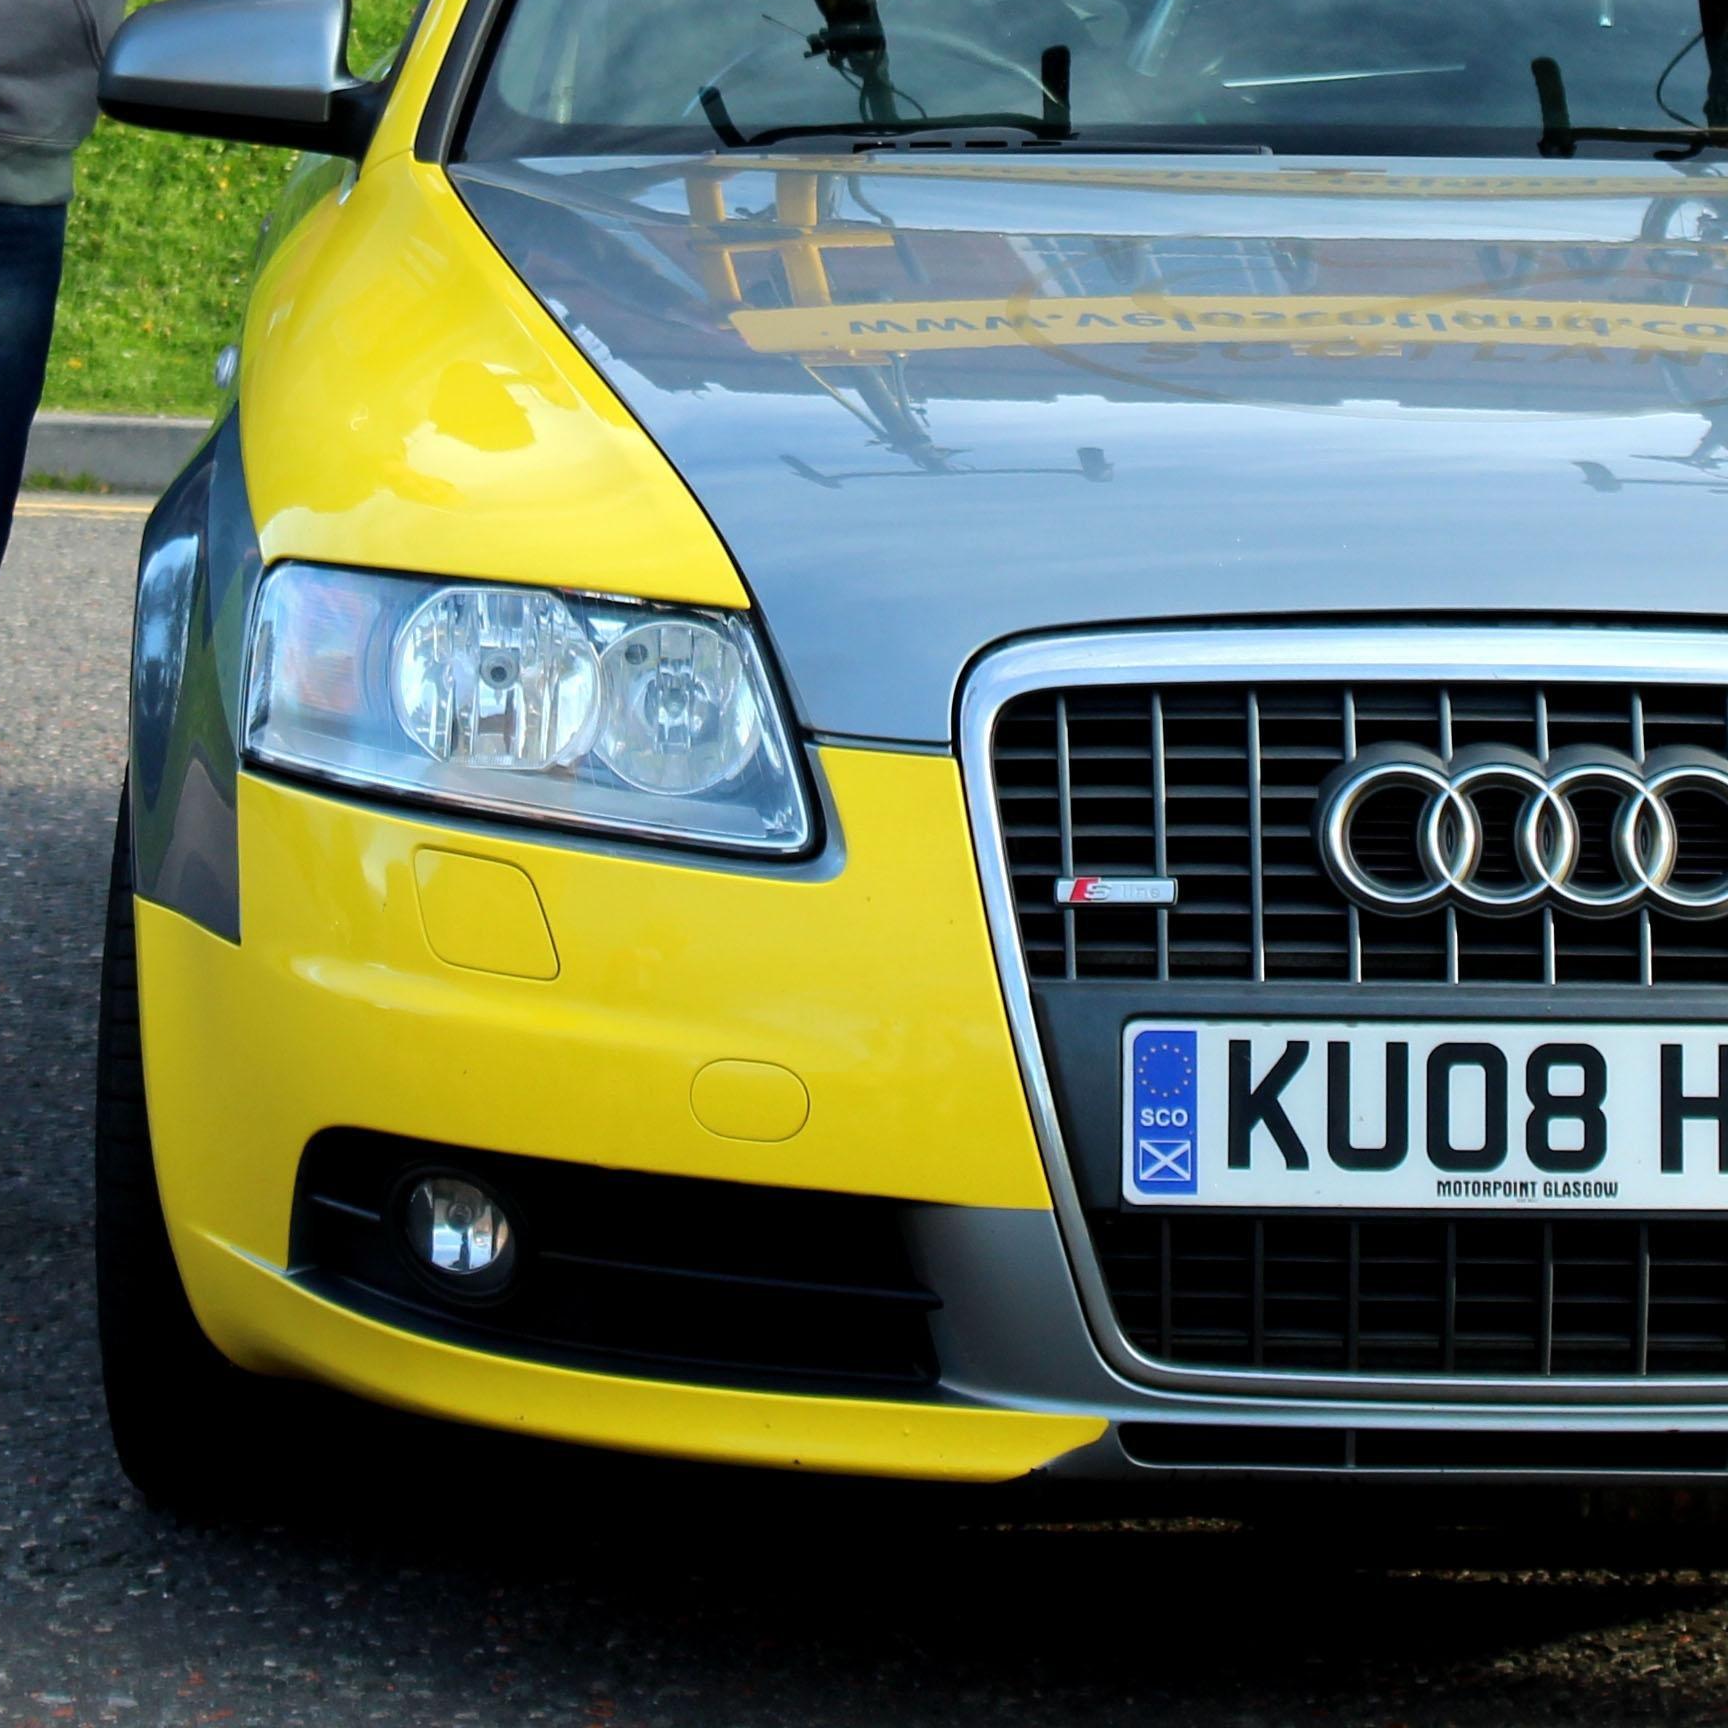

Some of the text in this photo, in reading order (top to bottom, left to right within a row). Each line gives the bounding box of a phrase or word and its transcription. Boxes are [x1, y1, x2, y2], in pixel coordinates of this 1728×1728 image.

[1121, 883, 1161, 899] line
[1227, 1039, 1607, 1173] KU08
[1140, 1108, 1189, 1127] SCO
[1437, 1180, 1619, 1198] MOTORPOINT GLASGOW
